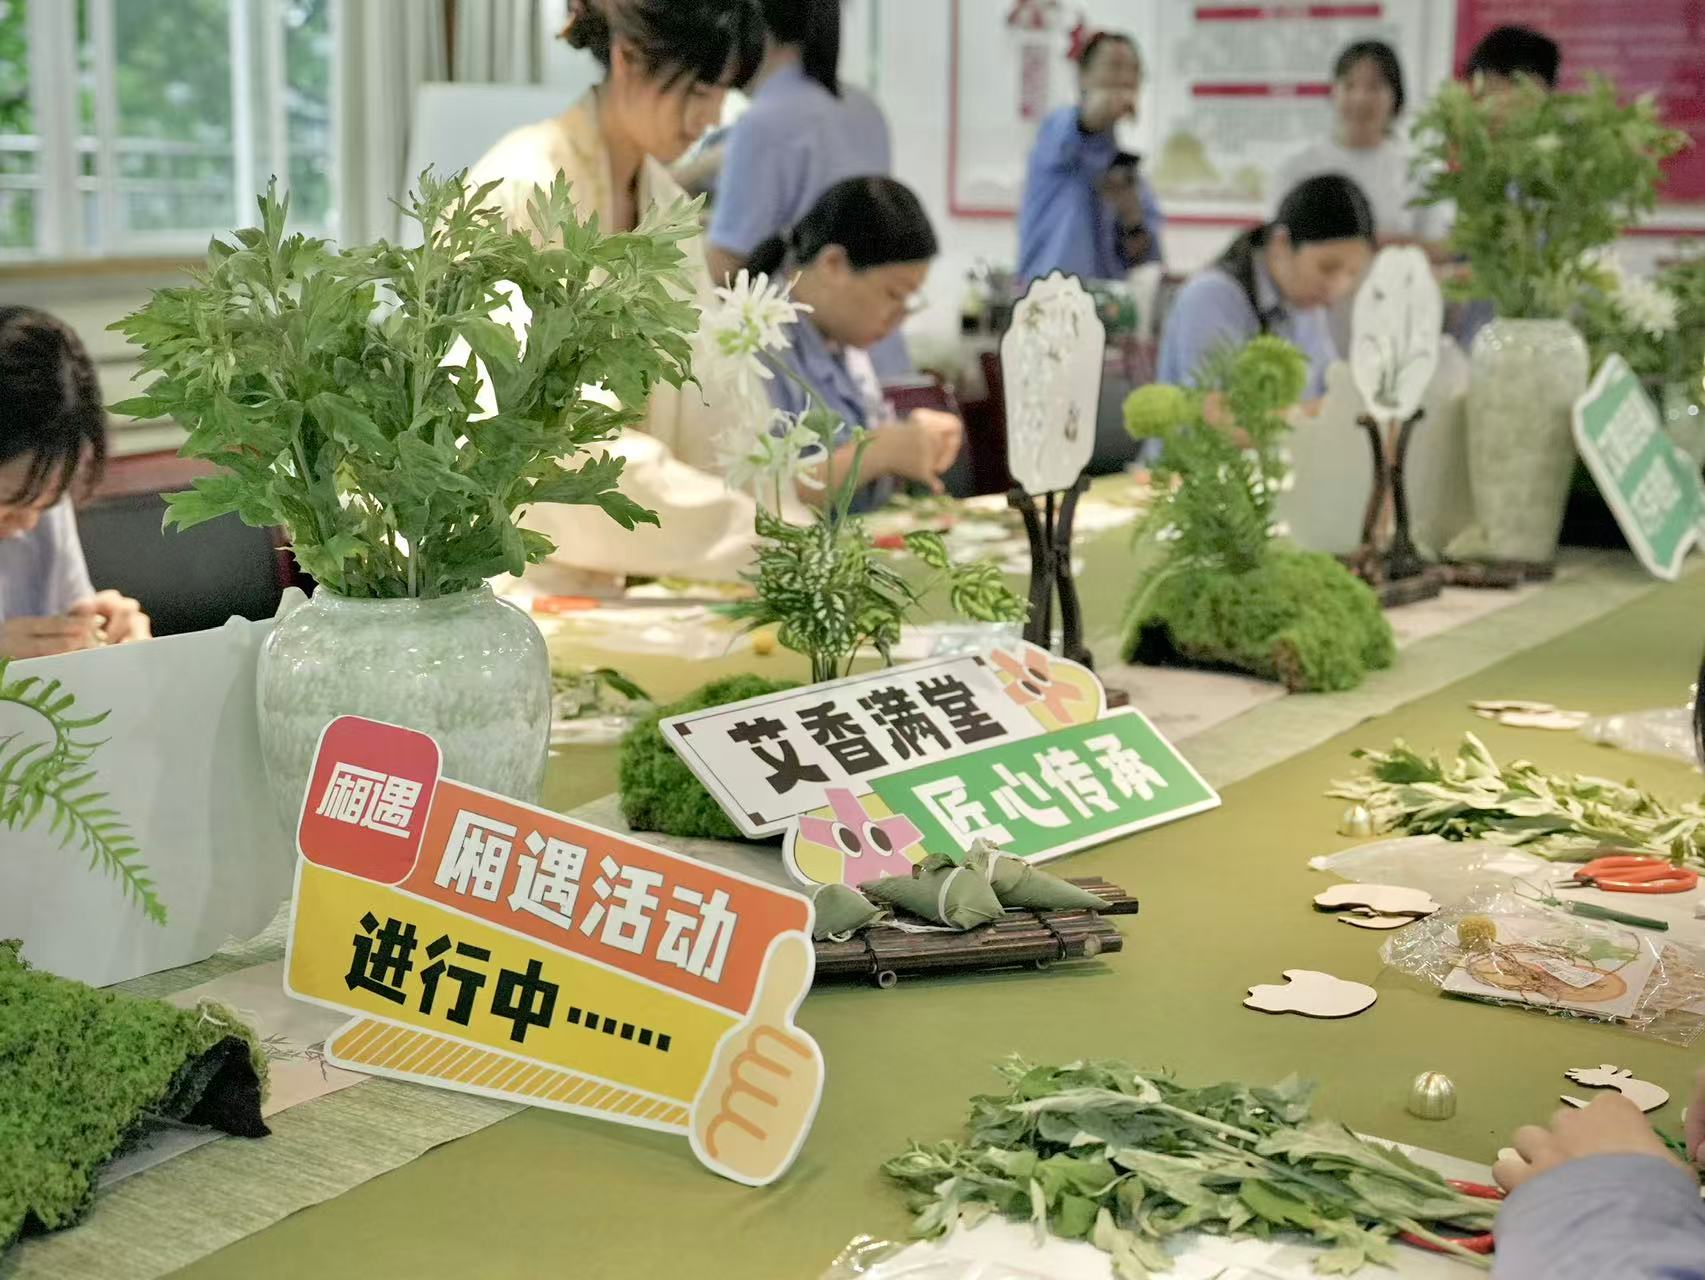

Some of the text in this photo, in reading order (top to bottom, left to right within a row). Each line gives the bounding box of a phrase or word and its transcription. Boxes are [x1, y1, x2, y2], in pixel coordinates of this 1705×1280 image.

[727, 675, 1008, 795] 艾香满堂
[912, 734, 1168, 850] 匠心传承
[316, 761, 423, 839] 厢遇
[435, 809, 738, 984] 厢遇活动
